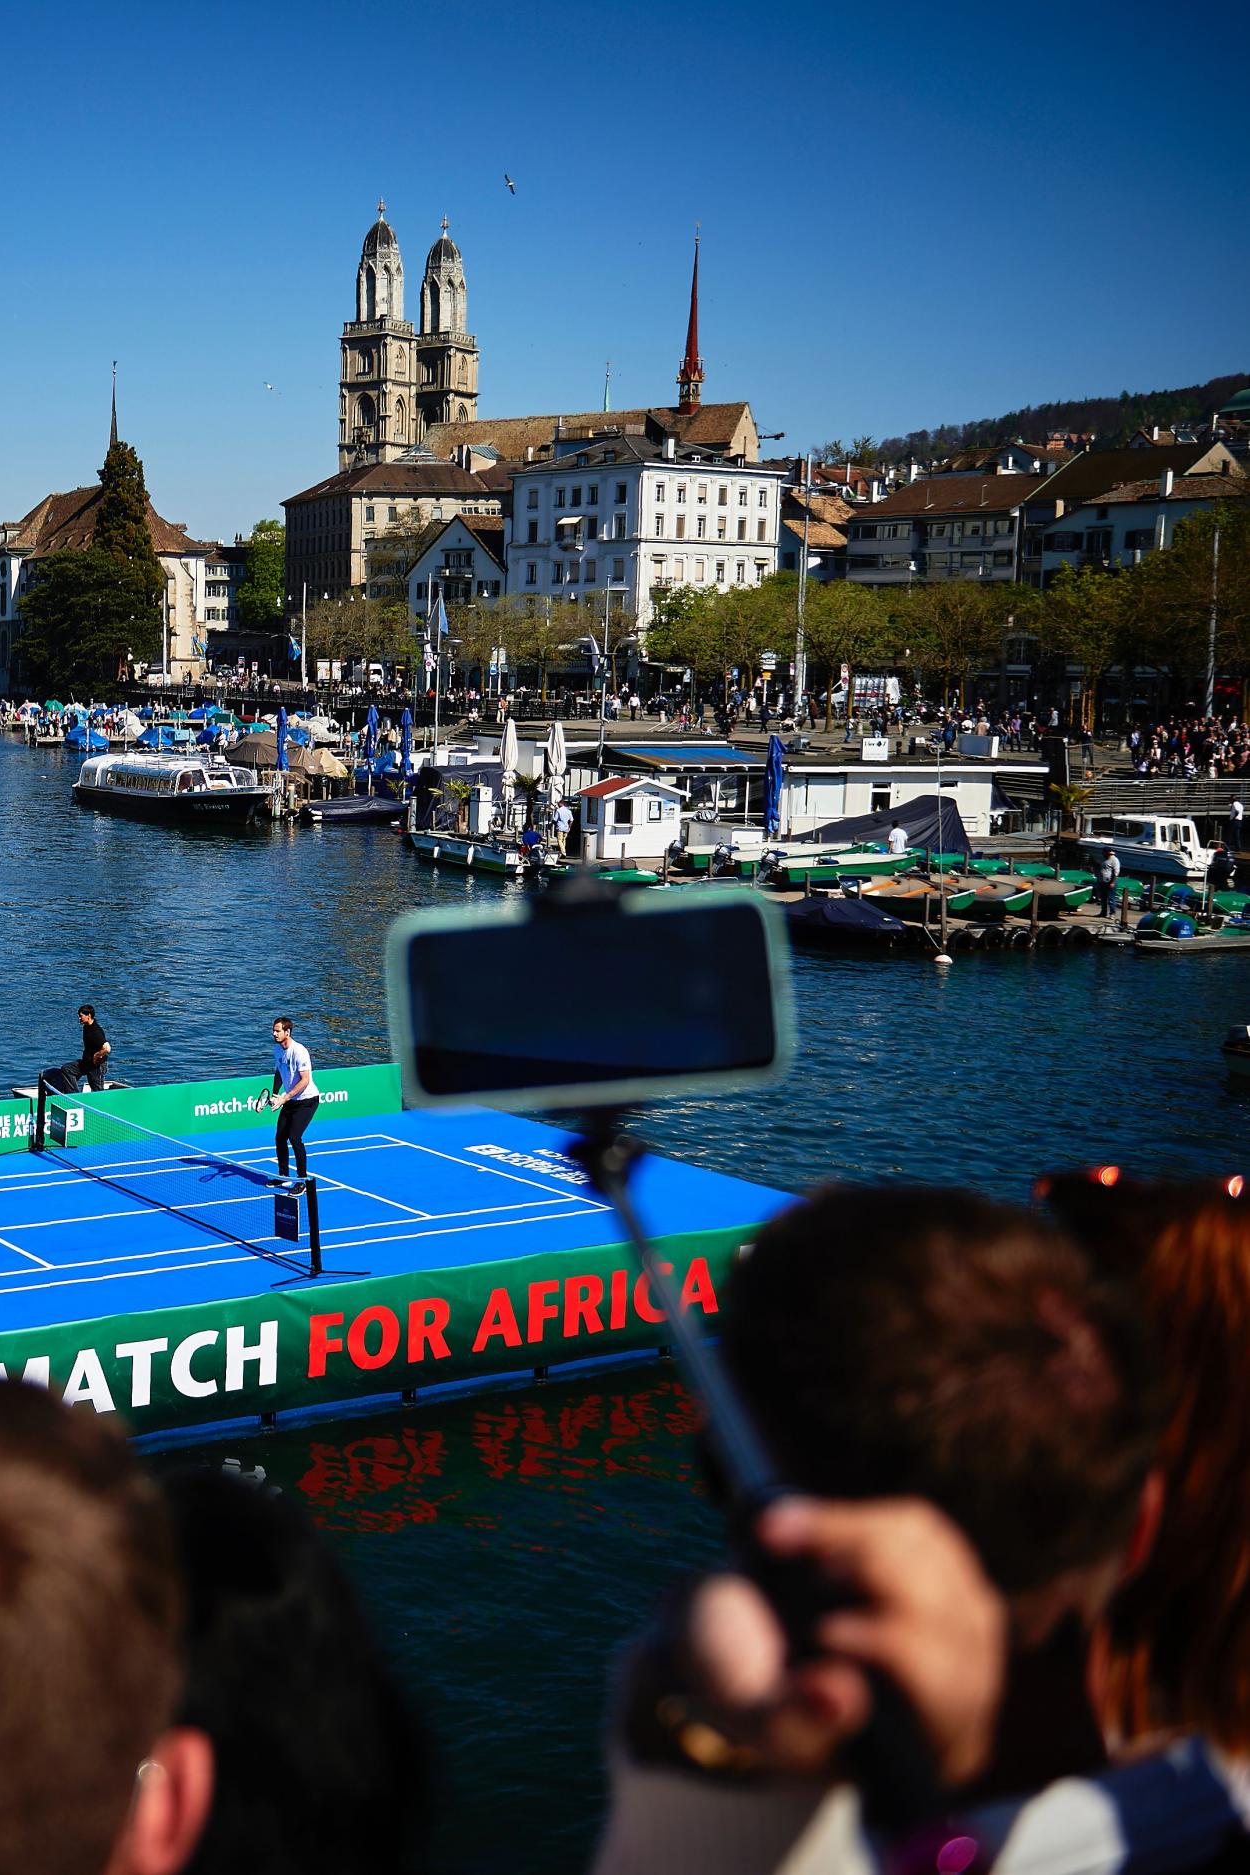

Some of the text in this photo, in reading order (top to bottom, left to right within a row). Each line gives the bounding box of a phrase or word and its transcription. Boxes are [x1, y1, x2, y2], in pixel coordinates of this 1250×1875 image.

[69, 1113, 79, 1128] 3
[307, 1297, 452, 1379] FOR
[471, 1257, 719, 1354] AFRICA
